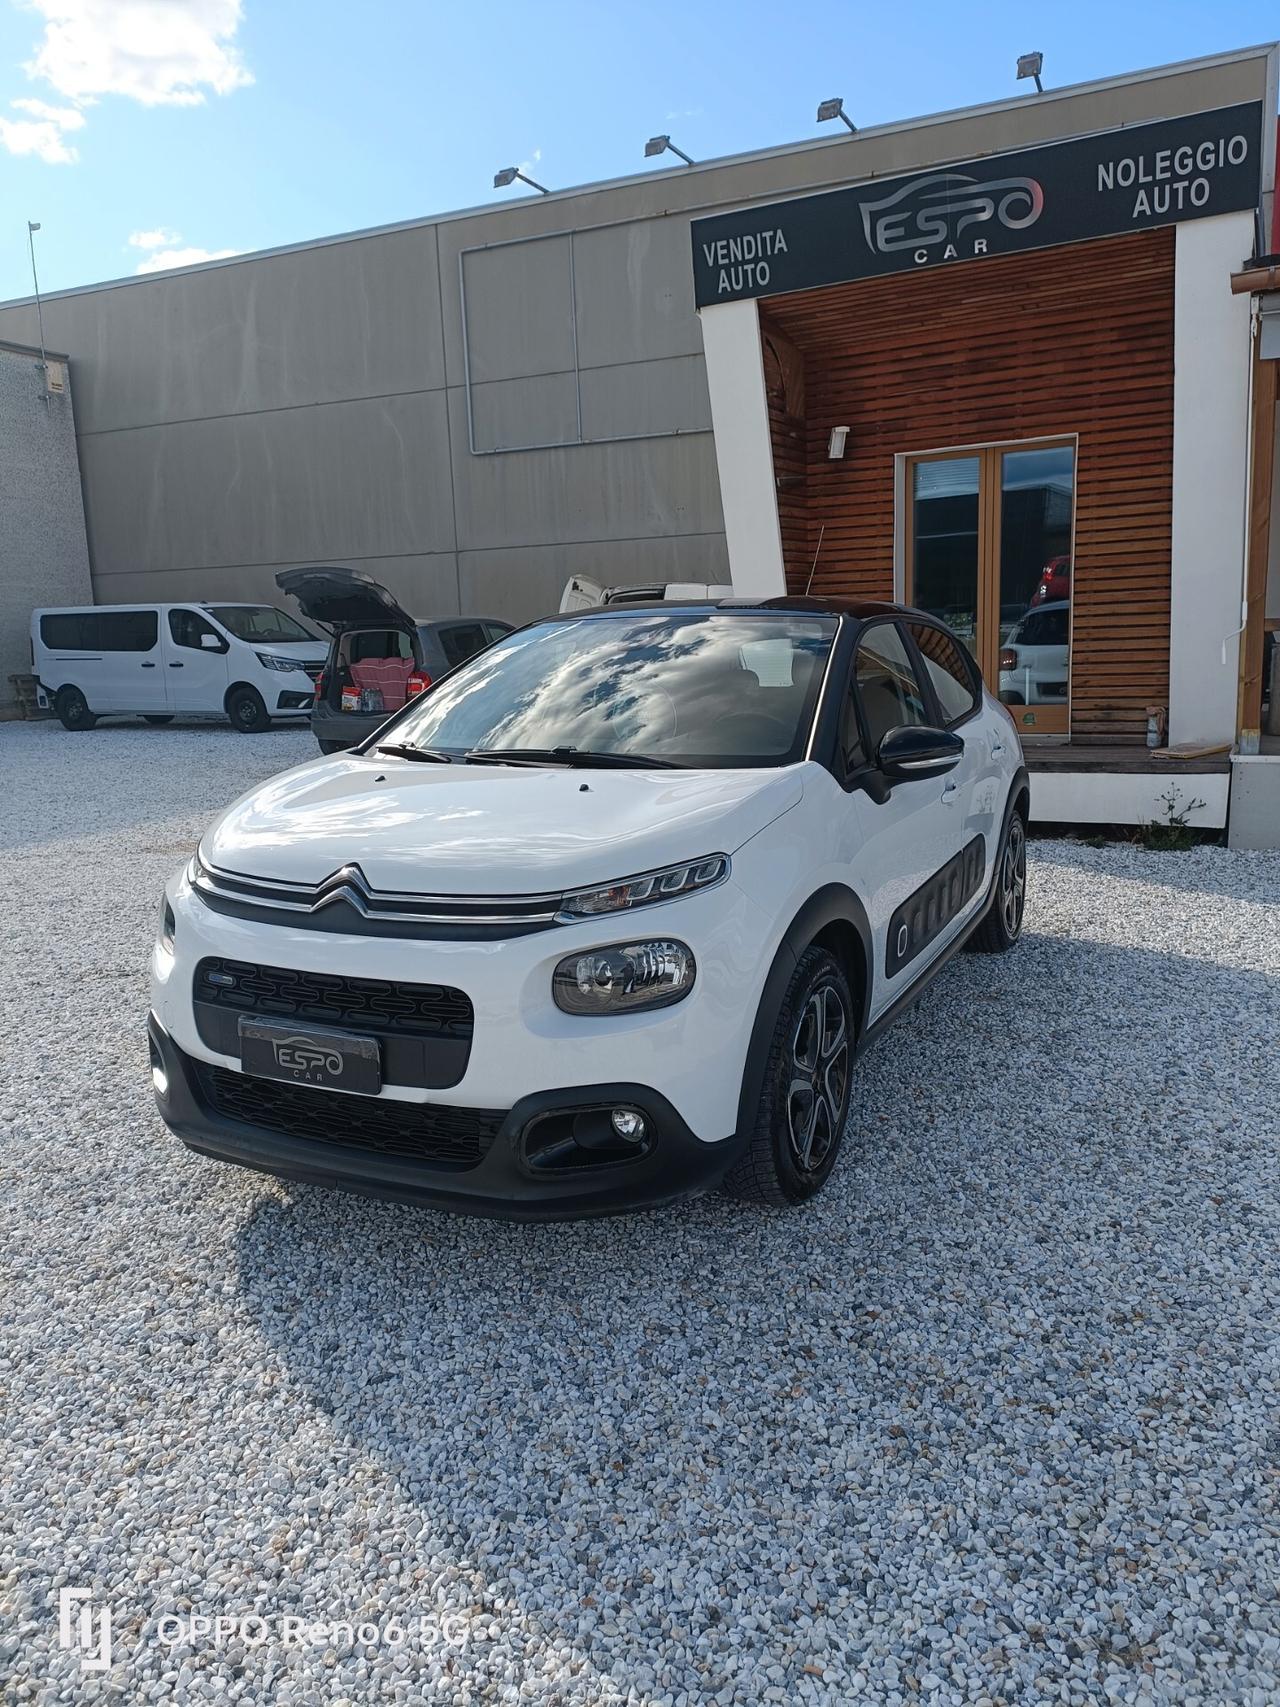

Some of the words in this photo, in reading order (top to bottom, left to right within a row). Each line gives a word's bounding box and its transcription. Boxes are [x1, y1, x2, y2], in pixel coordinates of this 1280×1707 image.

[1097, 135, 1248, 192] NOLEGGIO
[872, 177, 1044, 253] ESPO
[1132, 180, 1211, 218] AUTO
[703, 229, 788, 267] VENDITA
[913, 238, 988, 264] CAR
[717, 261, 770, 294] AUTO
[275, 1041, 344, 1076] ESPO
[293, 1070, 323, 1081] CAR
